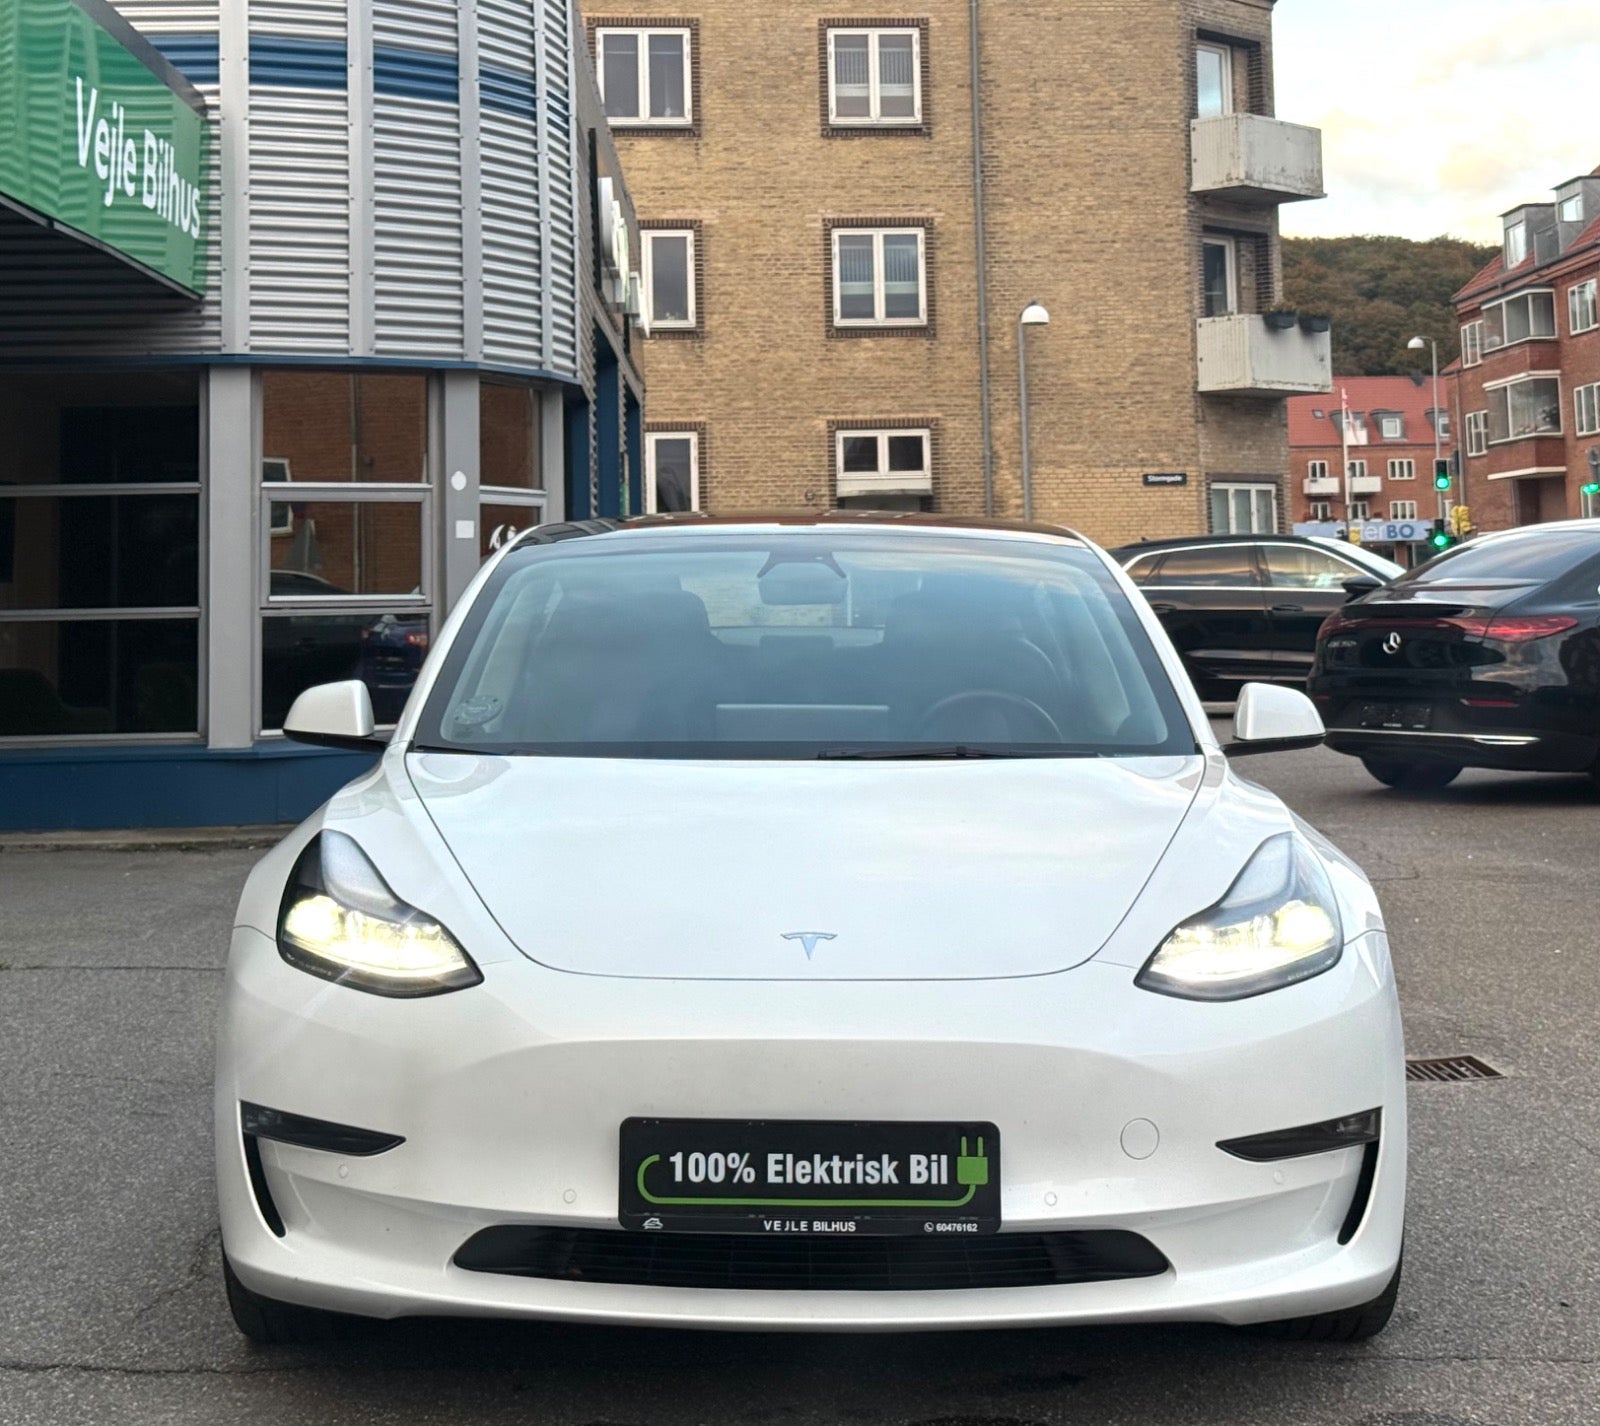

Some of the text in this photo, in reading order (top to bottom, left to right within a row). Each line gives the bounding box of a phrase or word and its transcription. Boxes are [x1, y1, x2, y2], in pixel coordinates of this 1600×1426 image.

[76, 76, 200, 239] Vejle Bilhus
[669, 1151, 948, 1185] 100% Elektrisk Bil
[763, 1220, 857, 1232] VEJLE BILHUS
[936, 1223, 978, 1232] 60476162
